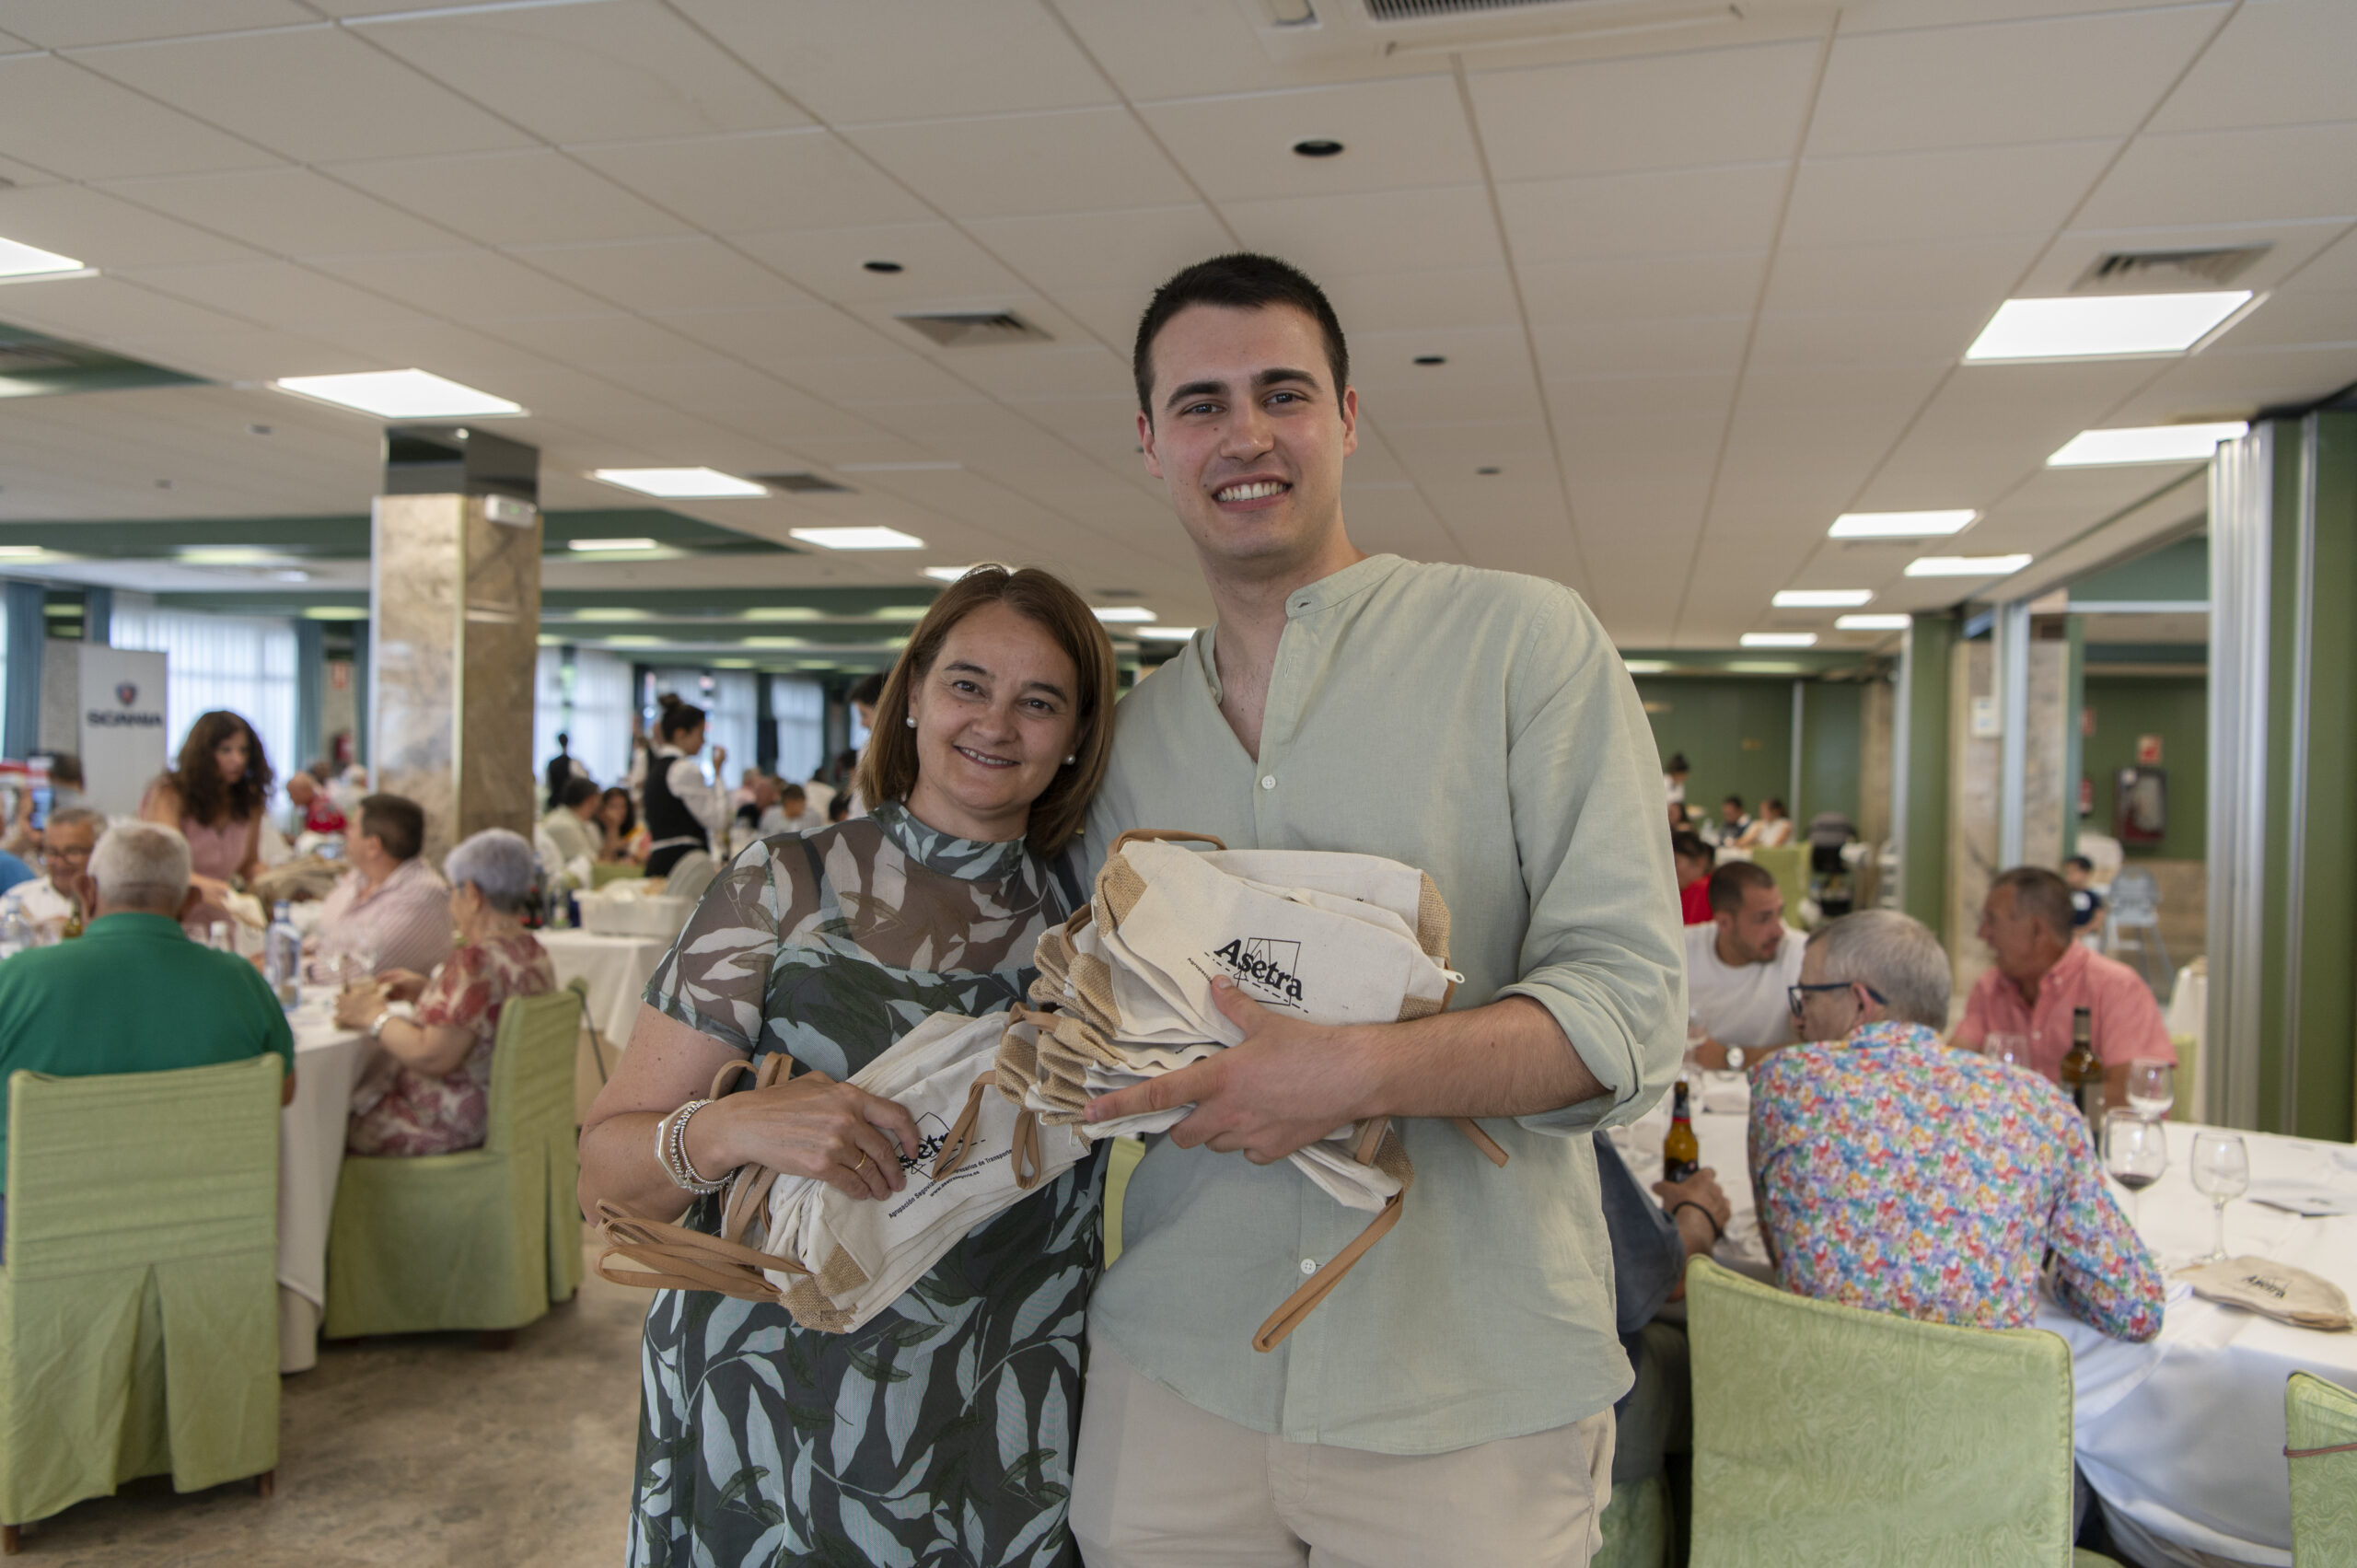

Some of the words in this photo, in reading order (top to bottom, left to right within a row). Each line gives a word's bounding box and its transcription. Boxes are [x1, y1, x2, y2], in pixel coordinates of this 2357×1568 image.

[1213, 938, 1303, 1001] Asetra
[888, 1197, 916, 1218] Agrupación
[914, 1179, 937, 1199] Segovian
